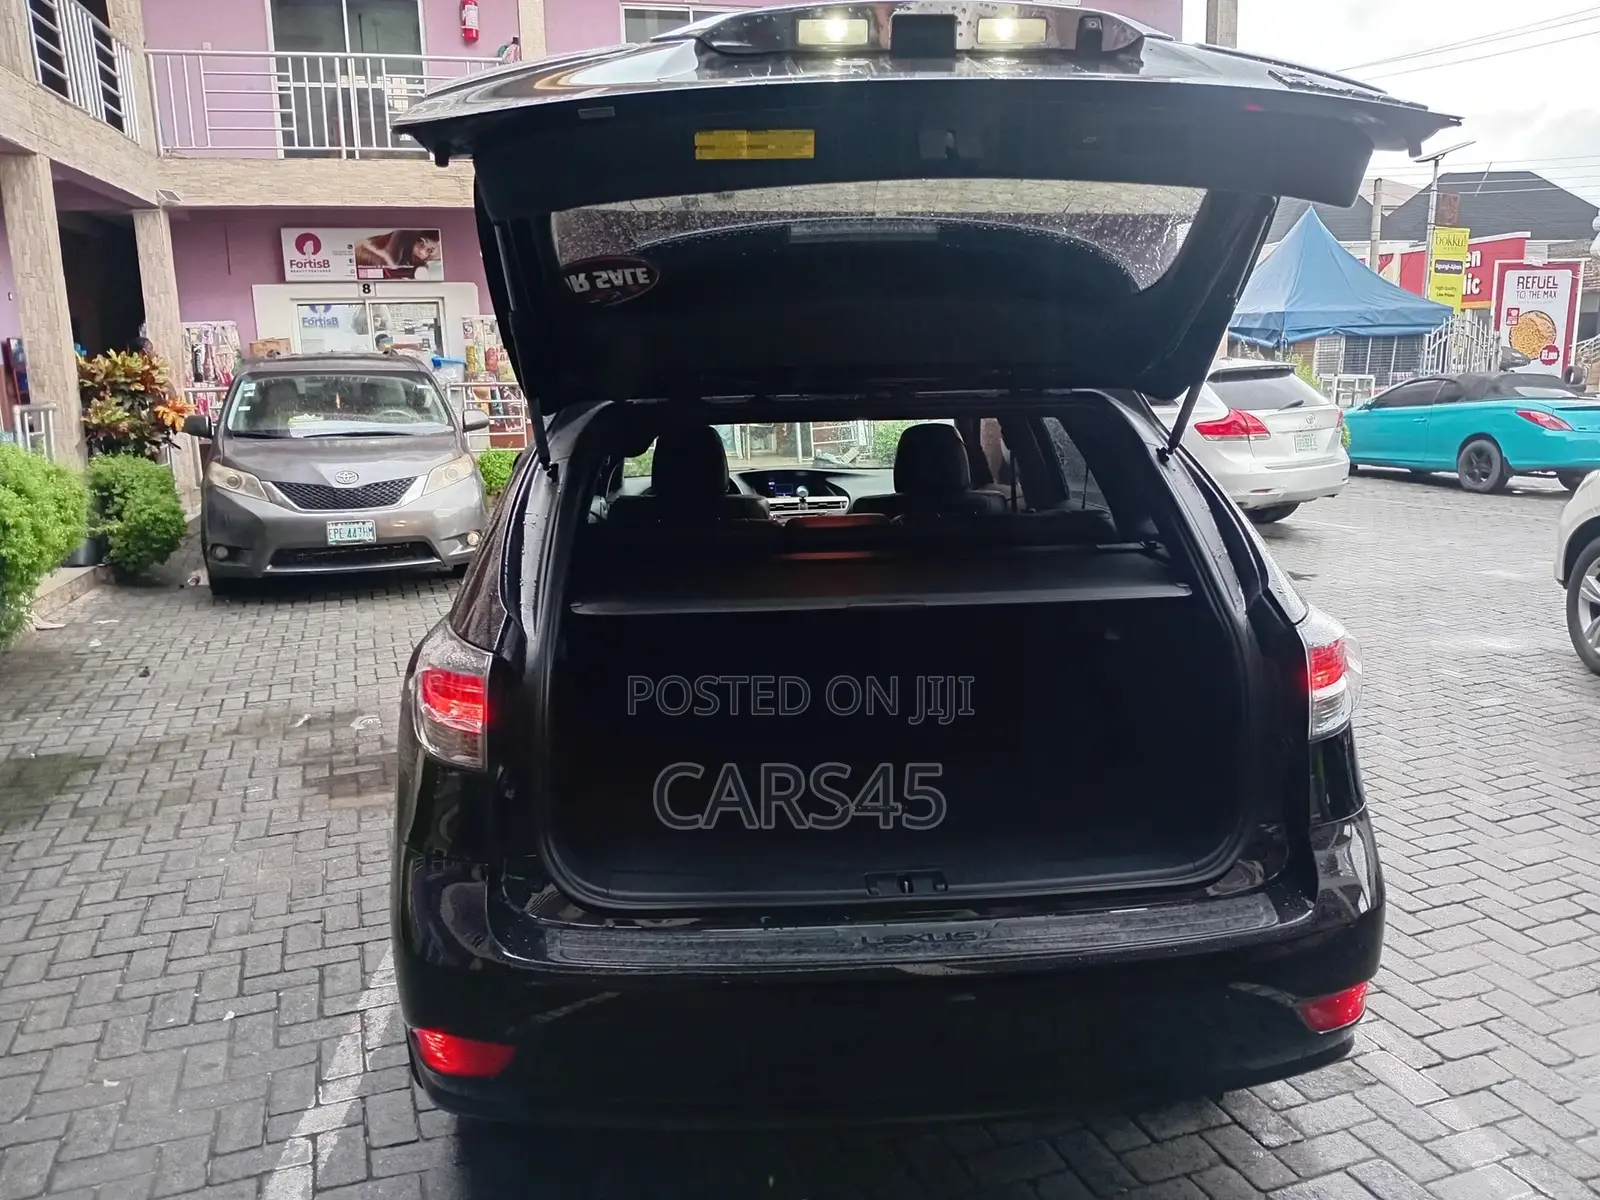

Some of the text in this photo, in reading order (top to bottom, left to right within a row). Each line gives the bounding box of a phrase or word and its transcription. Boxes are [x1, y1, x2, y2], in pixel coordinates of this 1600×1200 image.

[289, 259, 331, 269] FortisB
[1465, 250, 1481, 268] en
[362, 283, 371, 295] 8
[1462, 272, 1481, 295] lic
[1516, 275, 1558, 290] REFUEL
[1516, 290, 1557, 299] TO THE MAX
[301, 316, 339, 326] FortisB
[860, 931, 978, 948] LEXUS
